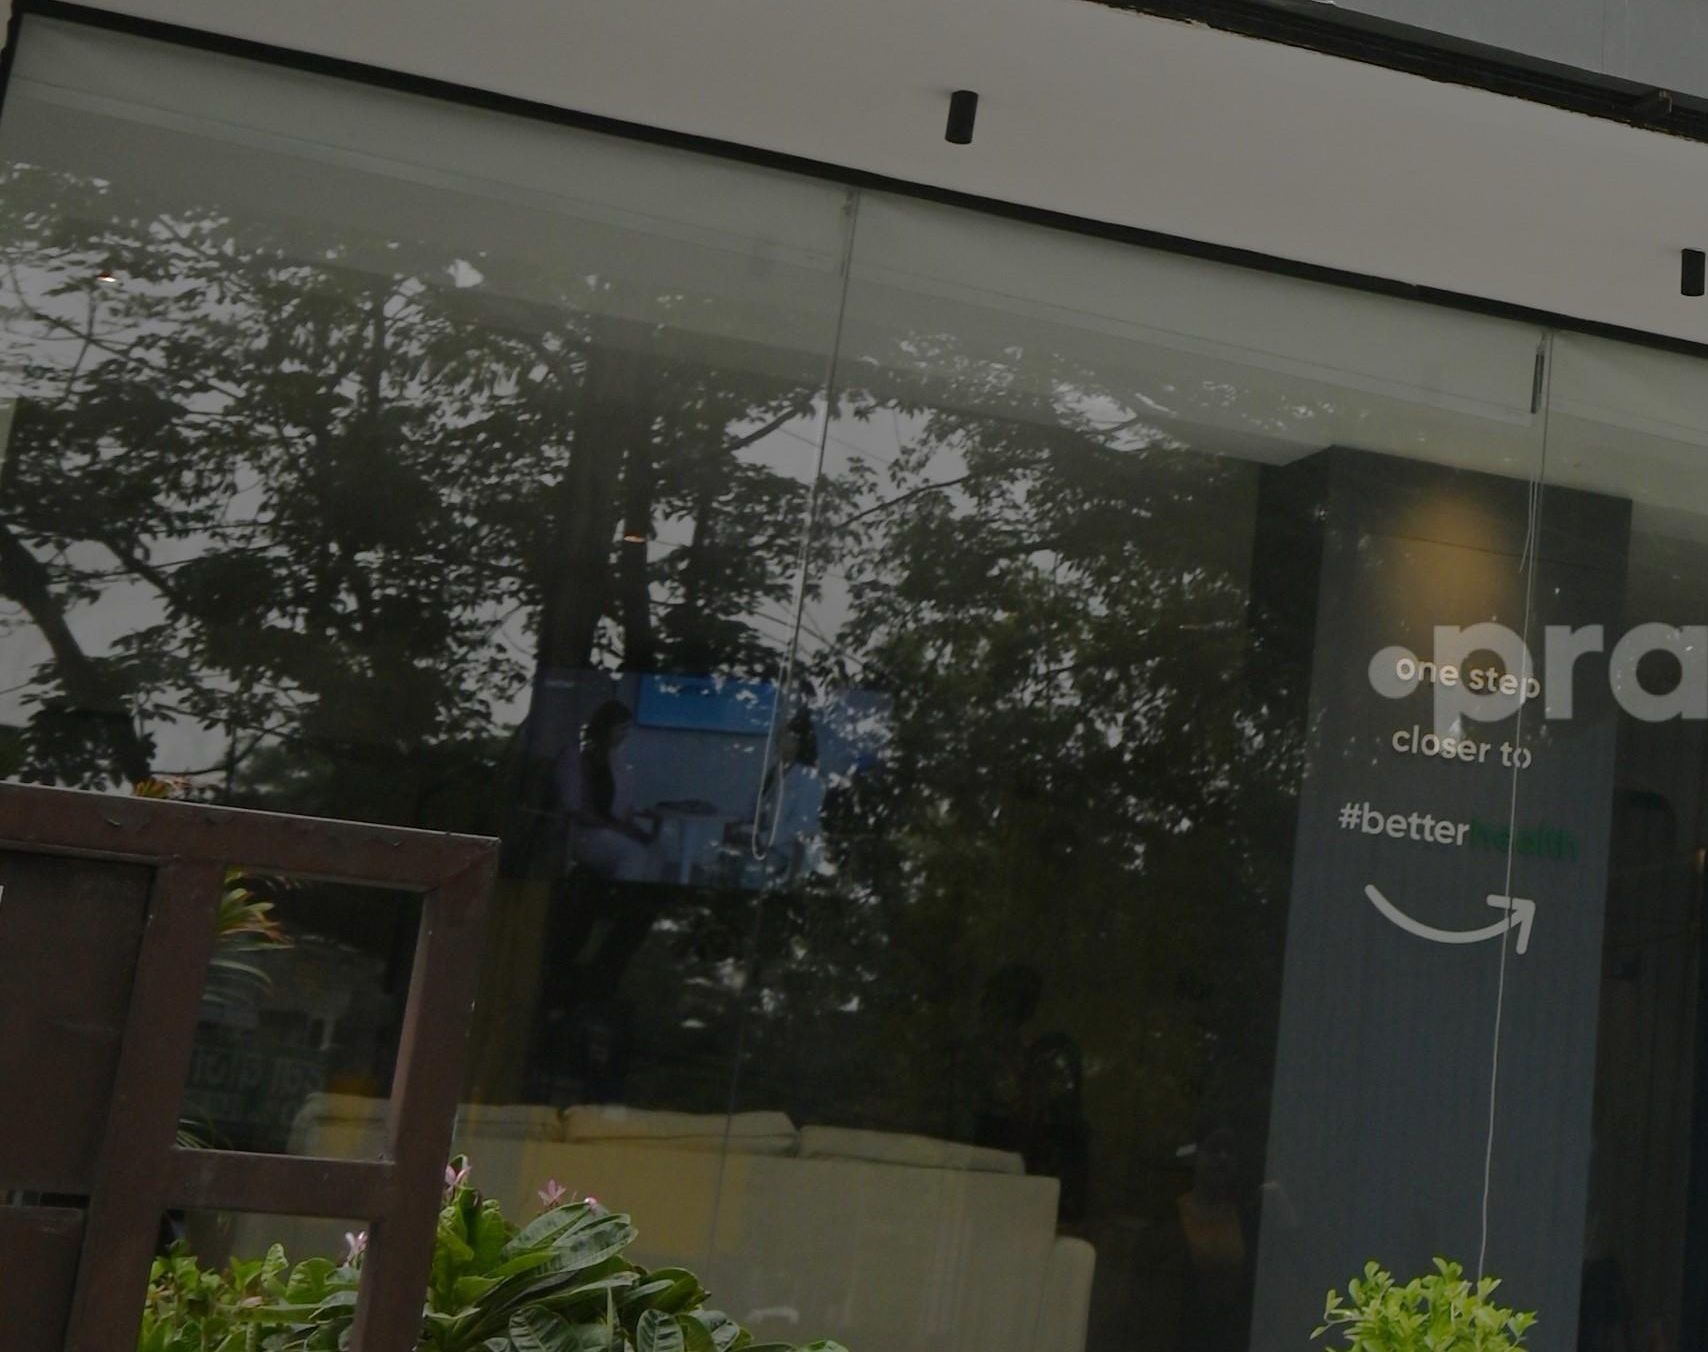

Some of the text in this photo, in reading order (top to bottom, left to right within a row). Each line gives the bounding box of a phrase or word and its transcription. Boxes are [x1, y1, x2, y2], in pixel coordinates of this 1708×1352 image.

[1395, 657, 1541, 703] one step
[1391, 724, 1533, 769] closer to
